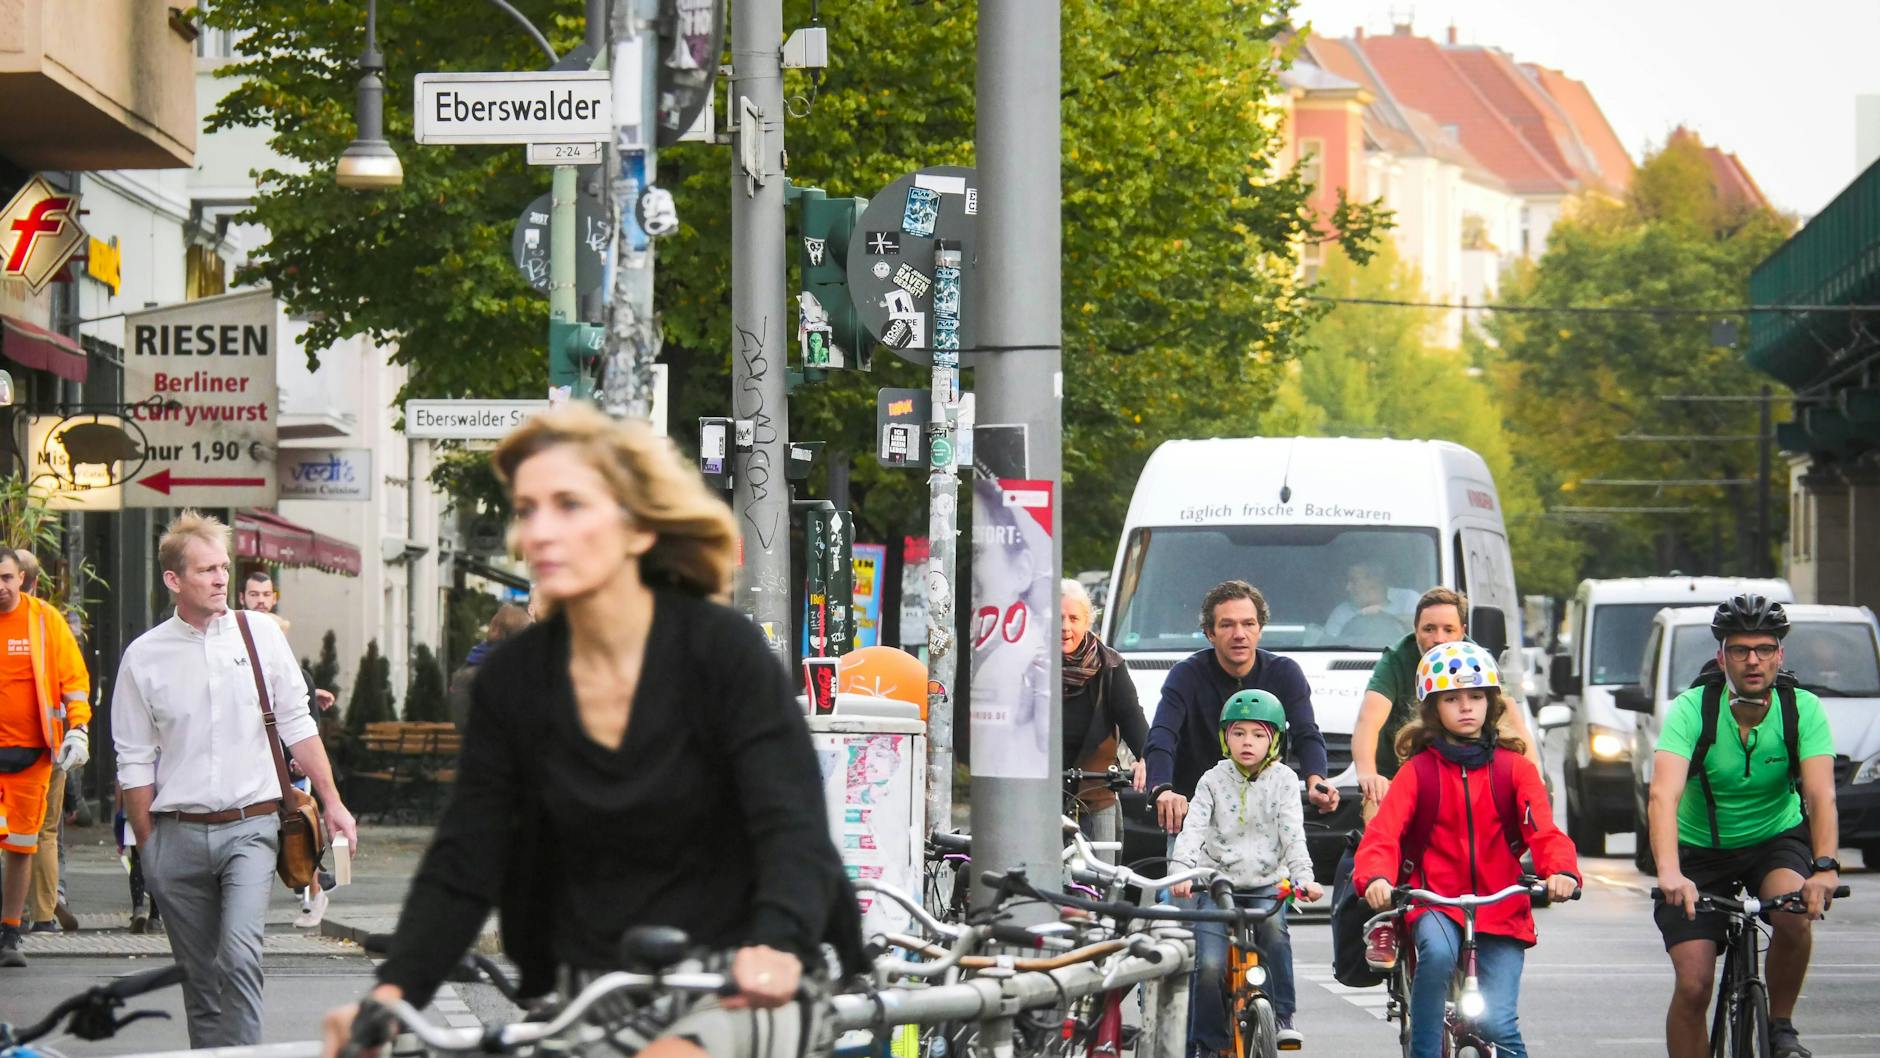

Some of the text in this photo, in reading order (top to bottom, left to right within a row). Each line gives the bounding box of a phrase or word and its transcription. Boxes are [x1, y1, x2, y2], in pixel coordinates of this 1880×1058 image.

[436, 90, 601, 122] Eberswalder
[555, 146, 581, 158] 2-24
[896, 267, 929, 293] RAVEN
[135, 324, 268, 356] RIESEN
[154, 371, 250, 393] Berliner
[132, 401, 268, 427] Currywurst
[416, 409, 505, 427] Eberswalder
[147, 445, 183, 461] nur
[192, 440, 240, 464] 1,90
[1180, 502, 1392, 522] täglich frische Backwaren
[974, 600, 1027, 650] DO
[1313, 686, 1359, 697] erei
